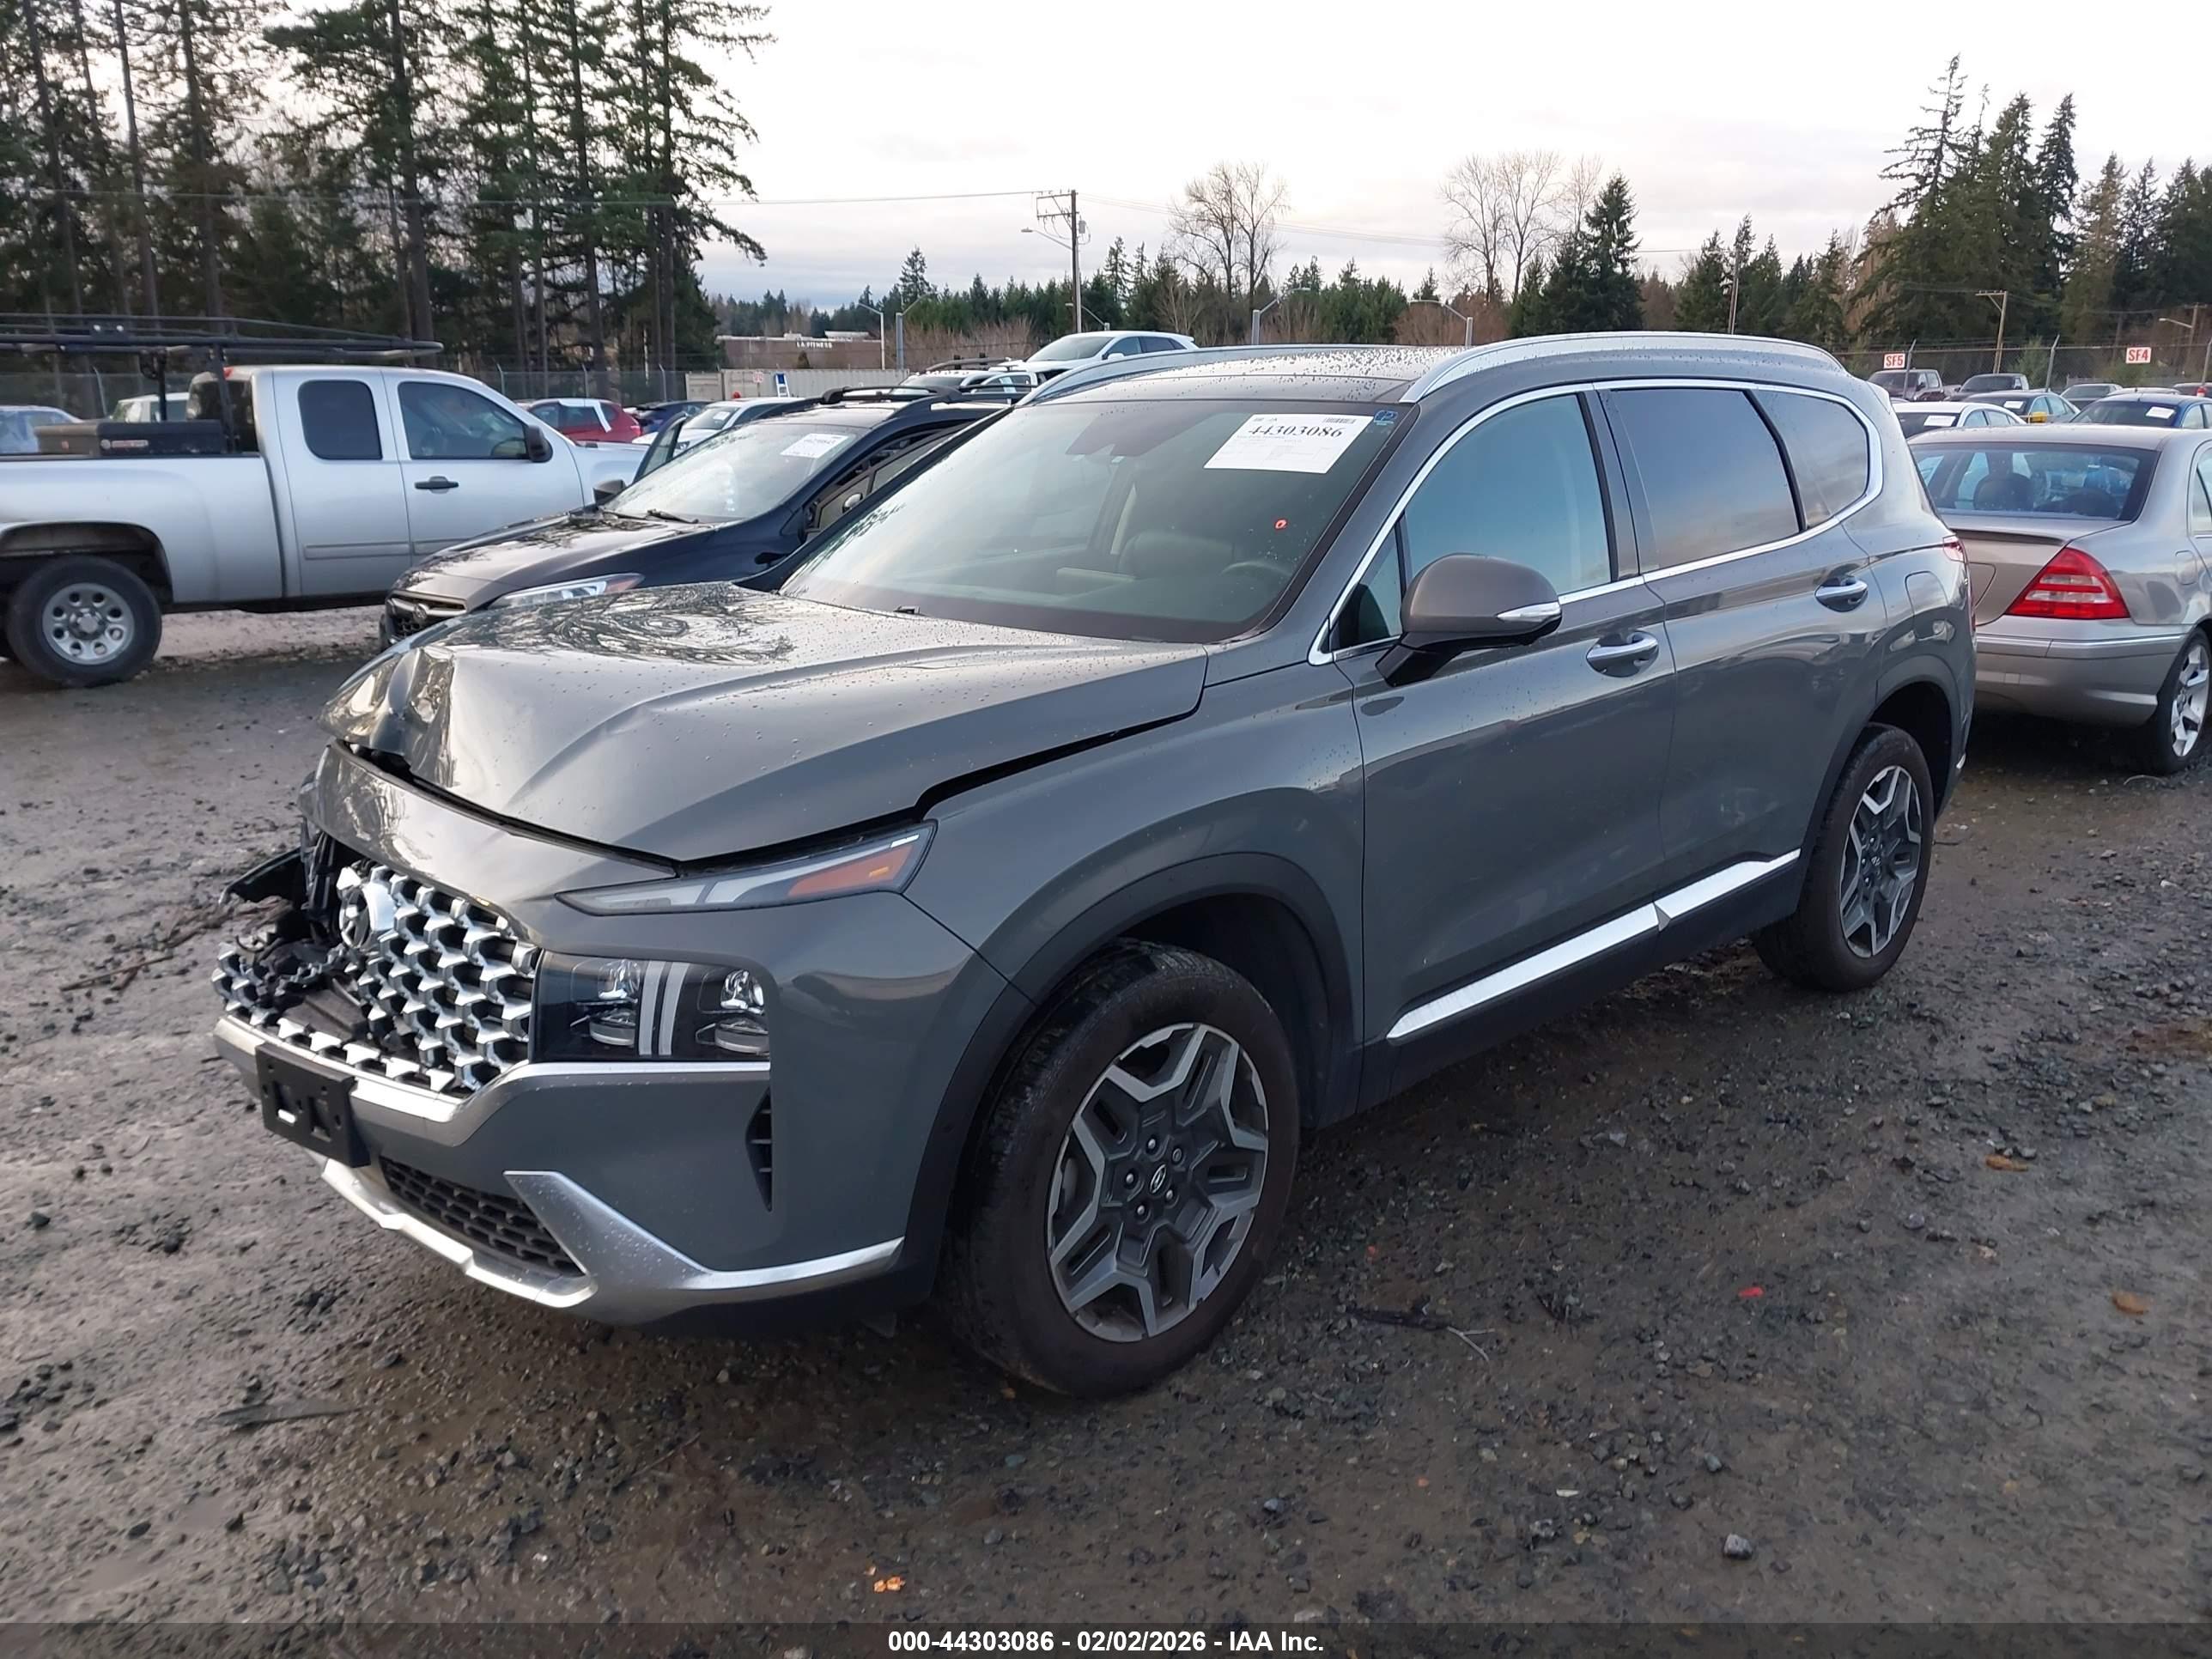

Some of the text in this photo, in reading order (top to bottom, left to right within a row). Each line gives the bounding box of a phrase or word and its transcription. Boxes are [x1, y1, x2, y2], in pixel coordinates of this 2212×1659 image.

[1886, 354, 1904, 367] SF5
[2129, 349, 2148, 362] SF4
[1249, 425, 1346, 437] 44303086
